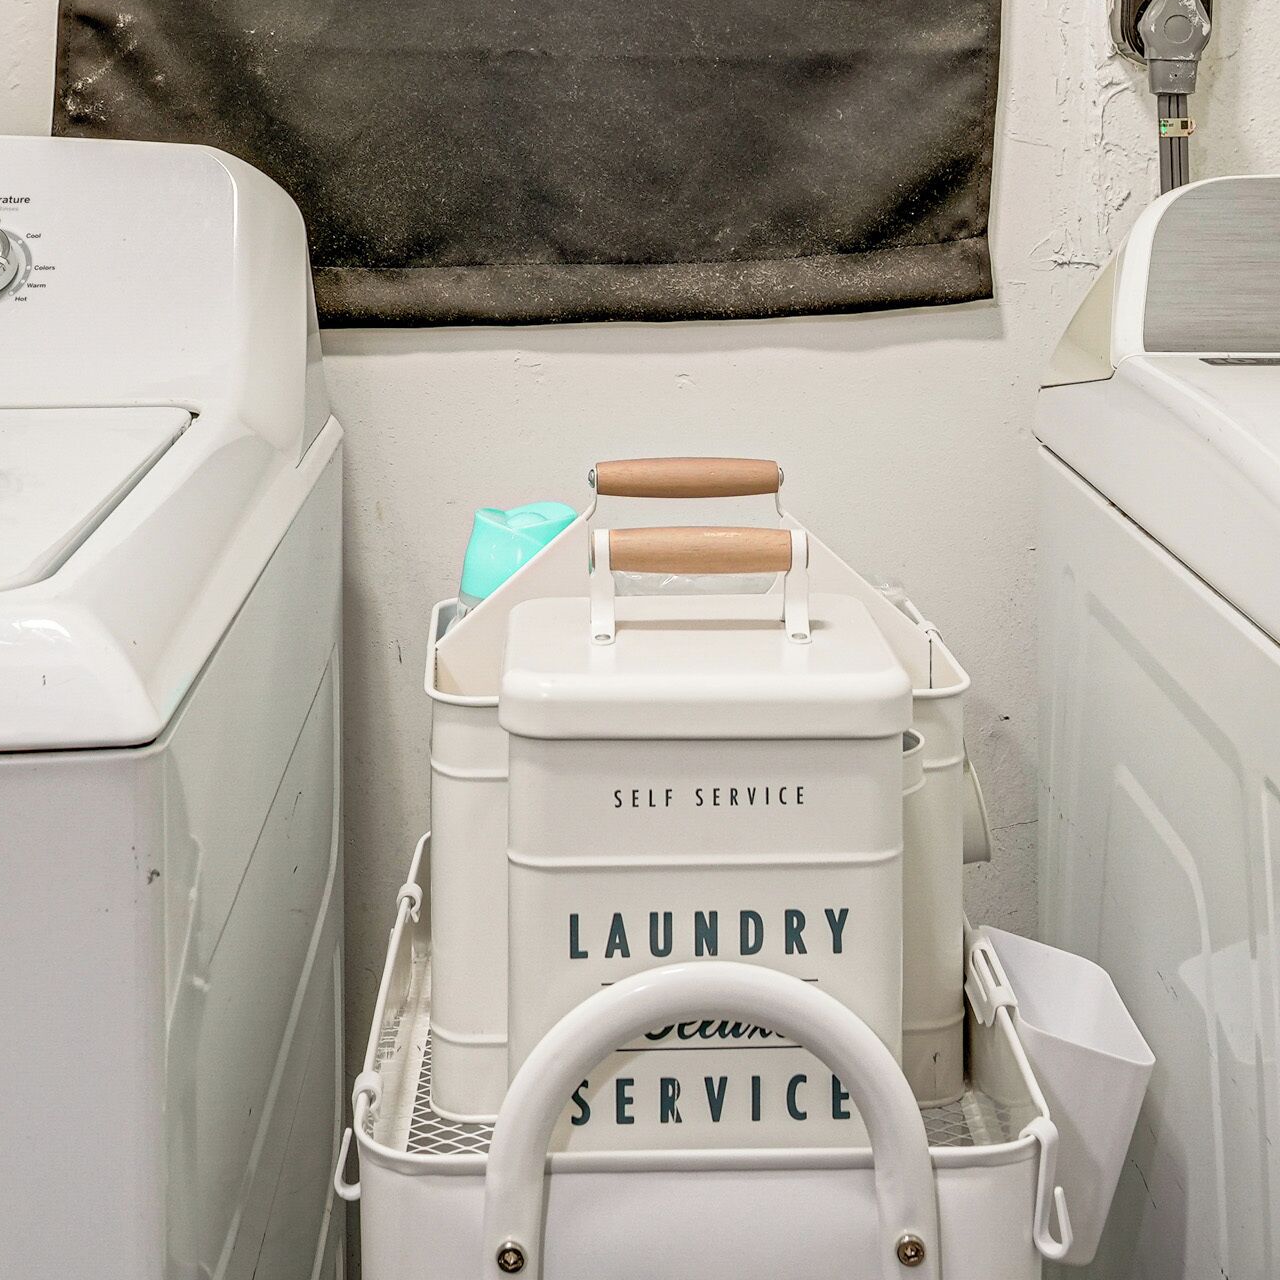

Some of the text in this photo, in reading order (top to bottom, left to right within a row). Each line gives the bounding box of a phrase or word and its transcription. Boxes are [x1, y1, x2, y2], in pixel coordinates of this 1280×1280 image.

[614, 786, 804, 808] SELF SERVICE
[569, 908, 849, 959] LAUNDRY
[571, 1074, 851, 1126] SERVICE
